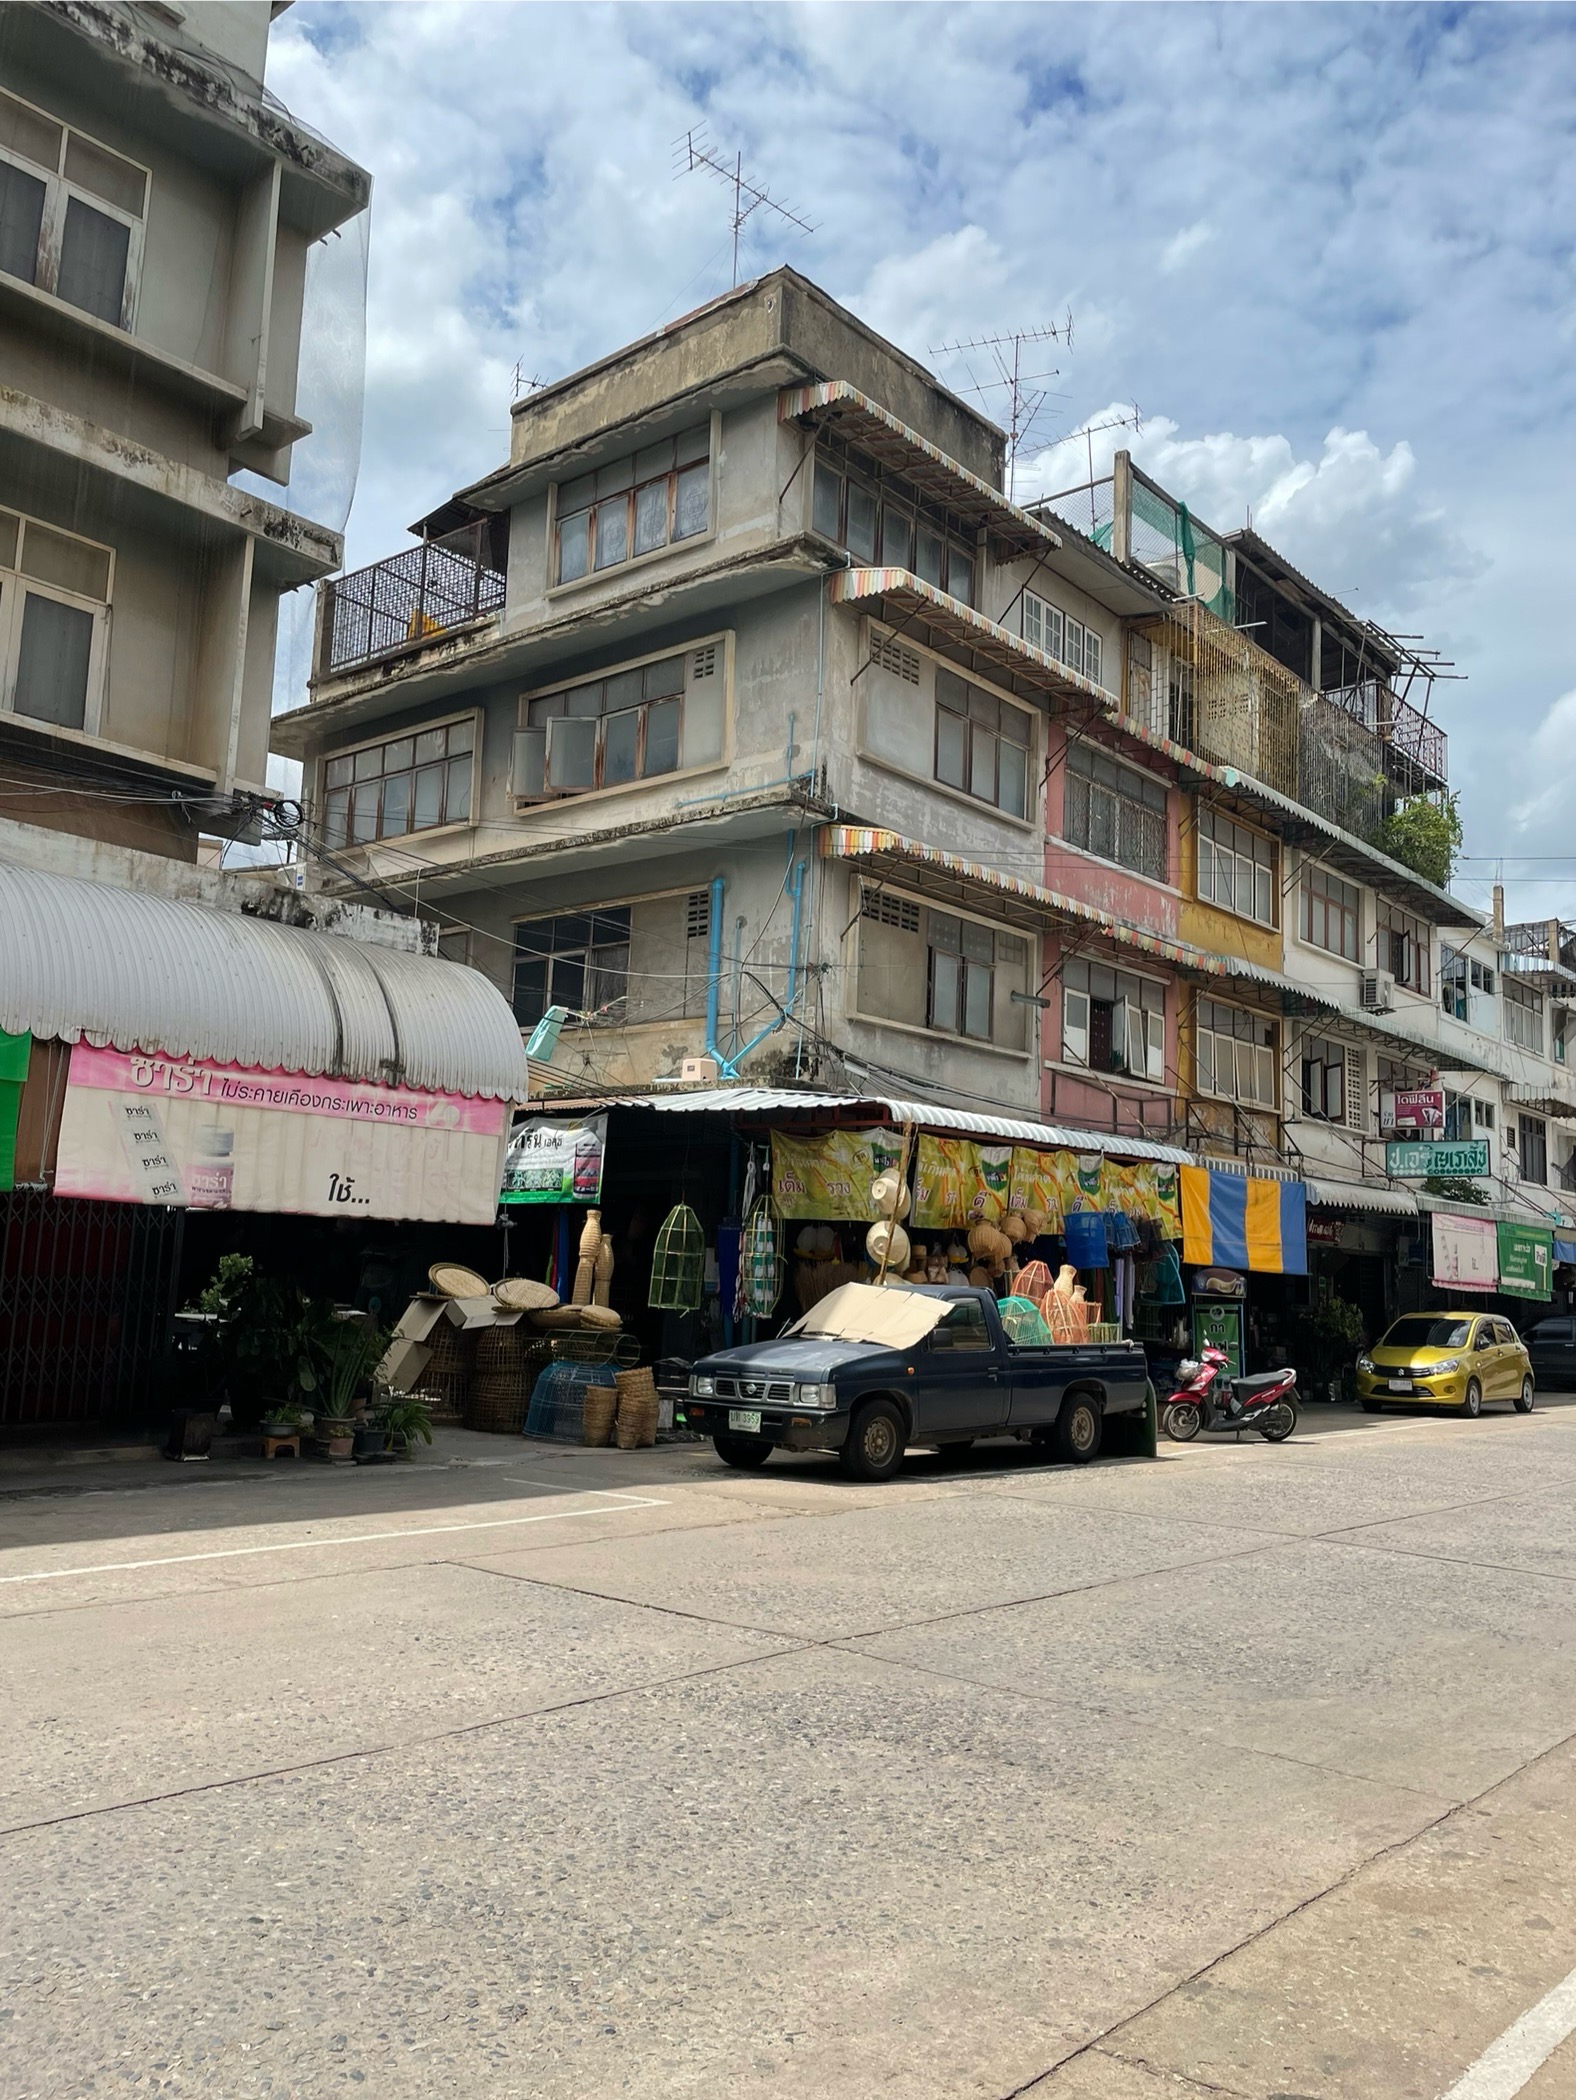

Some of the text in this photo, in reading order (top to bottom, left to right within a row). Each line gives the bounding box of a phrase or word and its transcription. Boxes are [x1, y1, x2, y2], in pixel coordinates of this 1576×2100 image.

[221, 1078, 418, 1120] ไม่ระคายเคืองกระเพาะอาหาร
[328, 1173, 371, 1205] ใช้...
